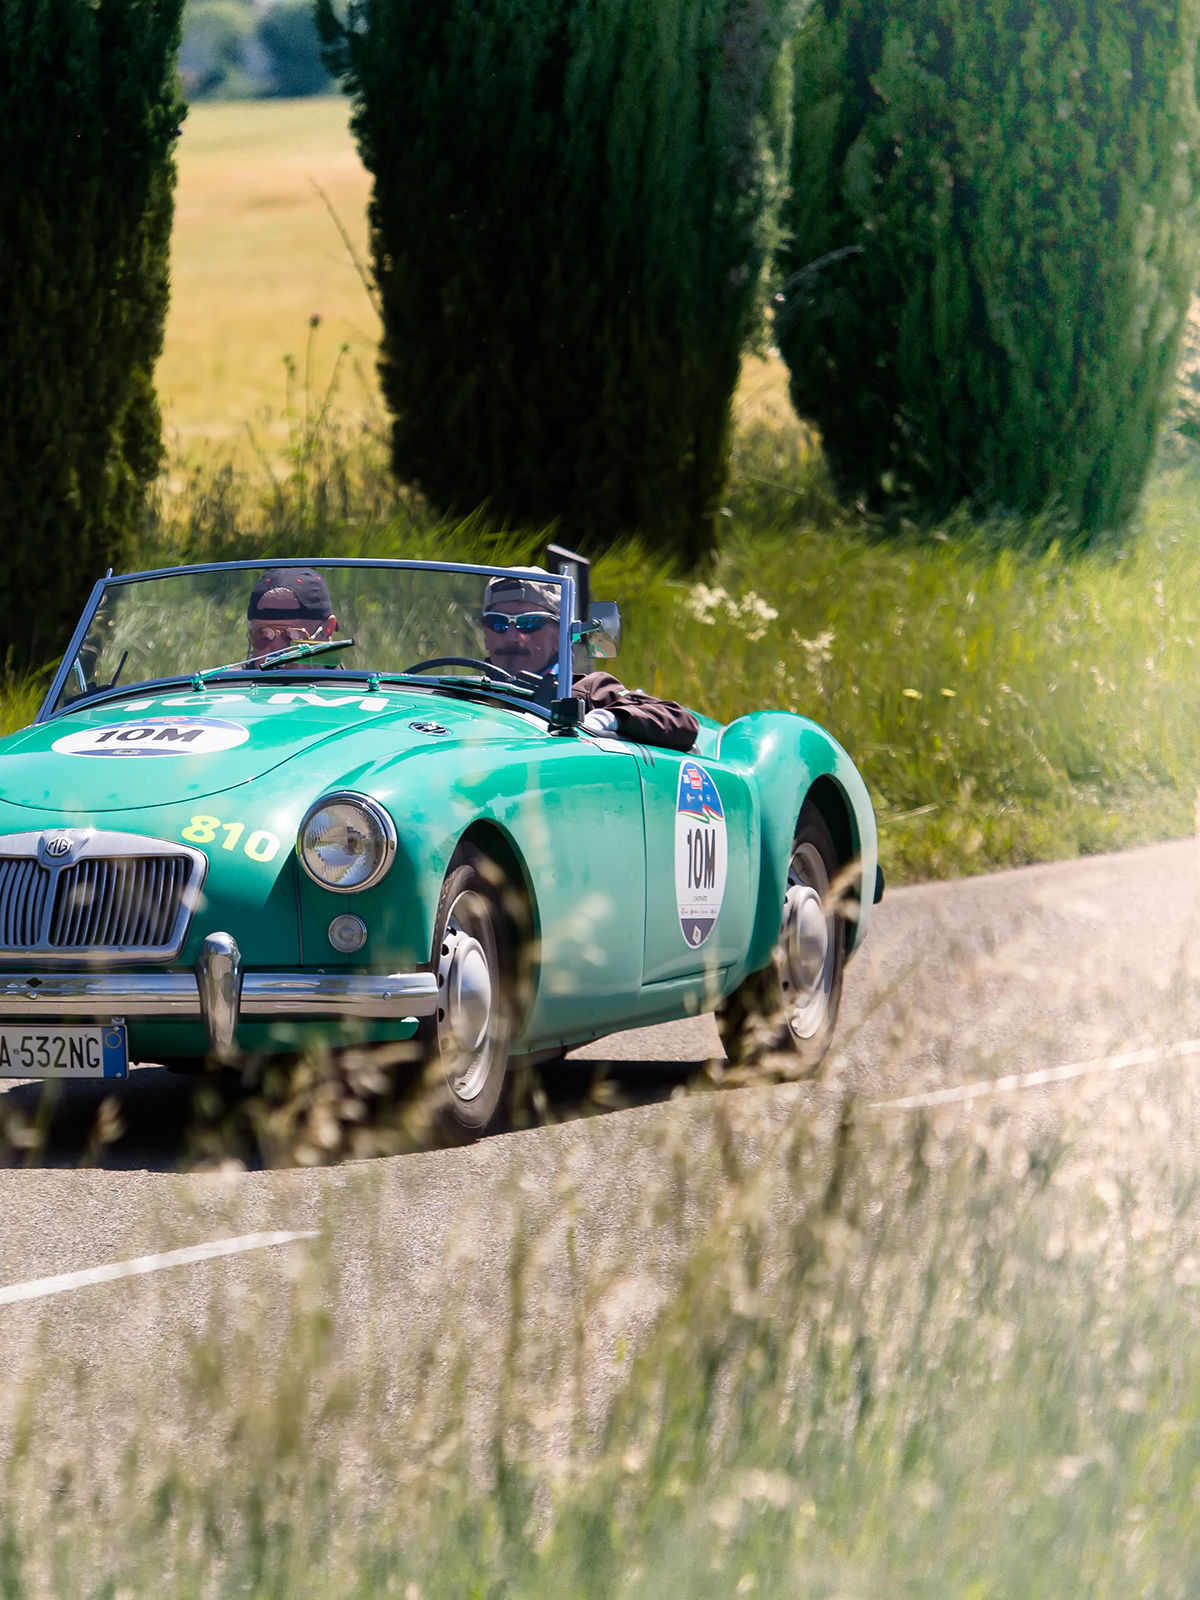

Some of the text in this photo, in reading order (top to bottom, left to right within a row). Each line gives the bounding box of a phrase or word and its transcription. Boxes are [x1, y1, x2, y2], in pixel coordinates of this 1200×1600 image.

[94, 727, 205, 743] 10M
[48, 838, 69, 854] MG
[181, 815, 281, 863] 810
[687, 828, 716, 889] 10M
